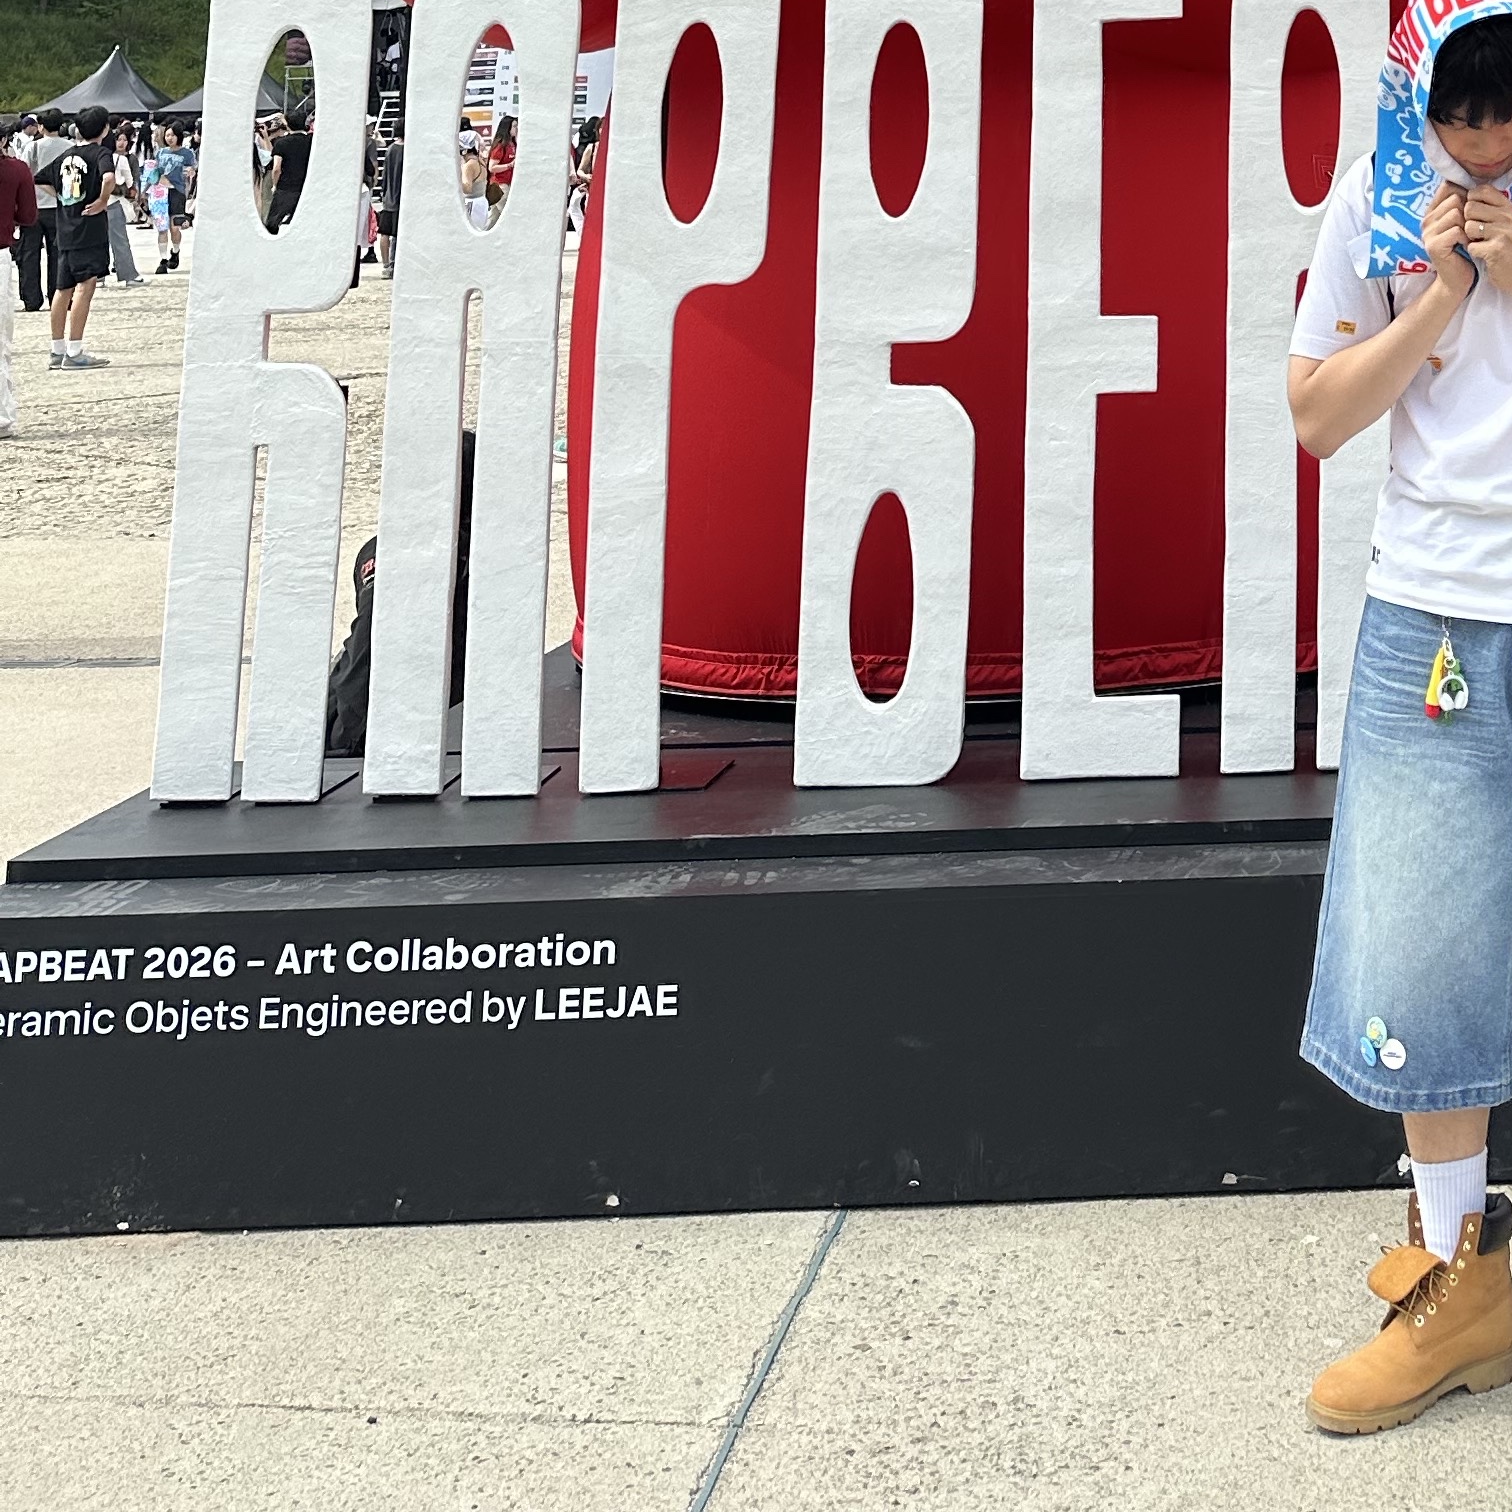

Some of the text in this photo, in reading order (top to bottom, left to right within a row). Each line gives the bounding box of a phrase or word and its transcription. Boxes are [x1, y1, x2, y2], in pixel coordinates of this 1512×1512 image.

[142, 946, 236, 979] 2026
[275, 943, 337, 975] Art
[346, 933, 616, 973] Collaboration
[0, 984, 679, 1040] ramic Objets Engineered by LEEJAE
